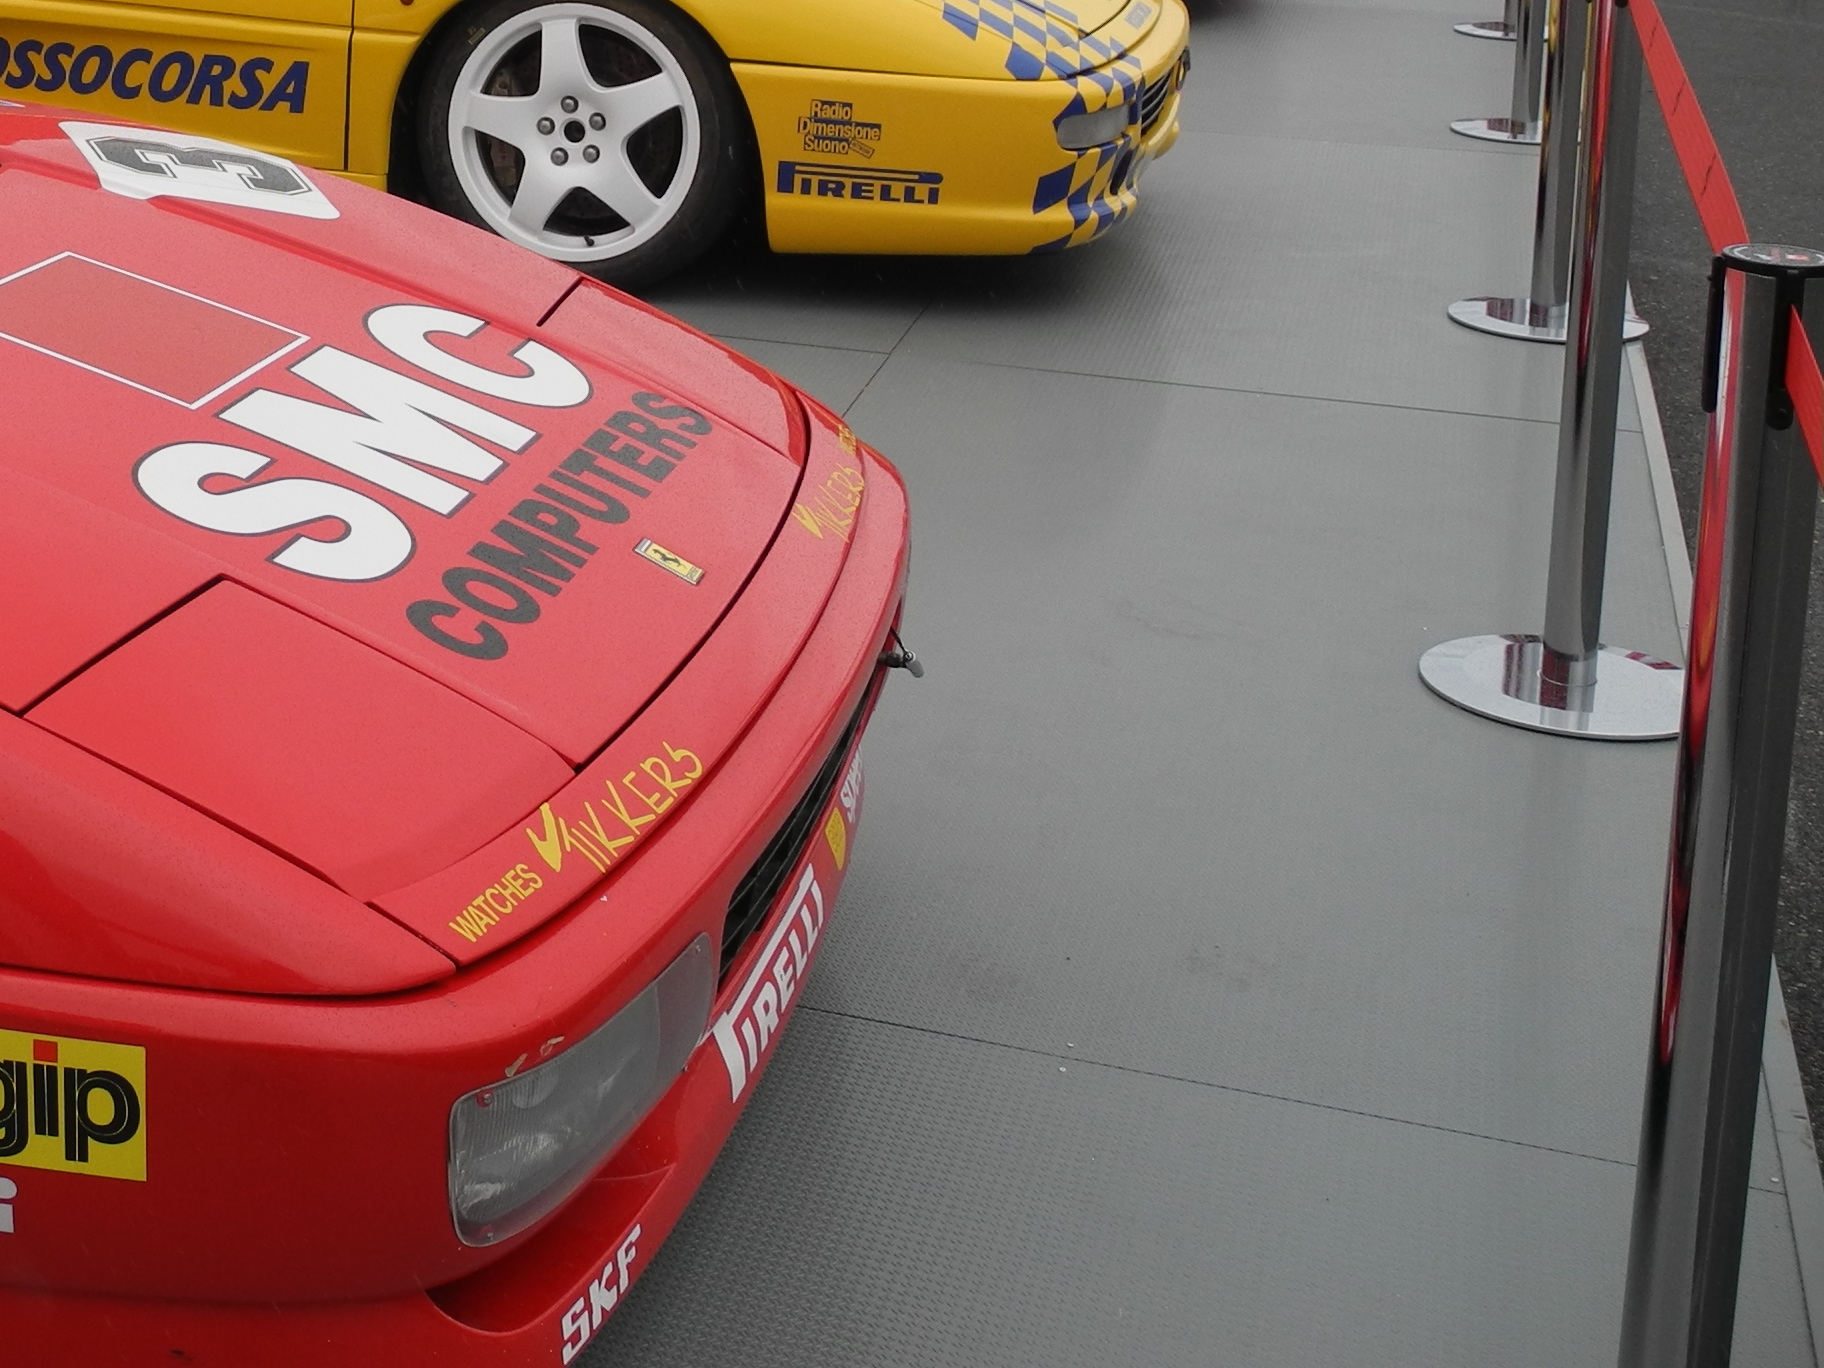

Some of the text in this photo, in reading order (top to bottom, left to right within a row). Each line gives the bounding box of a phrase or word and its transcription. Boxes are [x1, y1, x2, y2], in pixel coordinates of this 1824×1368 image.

[799, 117, 881, 140] Dimensione
[804, 135, 849, 154] Suono
[811, 100, 852, 120] Radio
[85, 135, 312, 196] 3
[777, 161, 943, 204] PIRELLI
[132, 302, 594, 582] SMC
[405, 390, 714, 660] COMPUTERS
[448, 741, 704, 944] WATCHES TIKKERS
[712, 863, 825, 1104] PIRELLI
[561, 1223, 642, 1365] SKF
